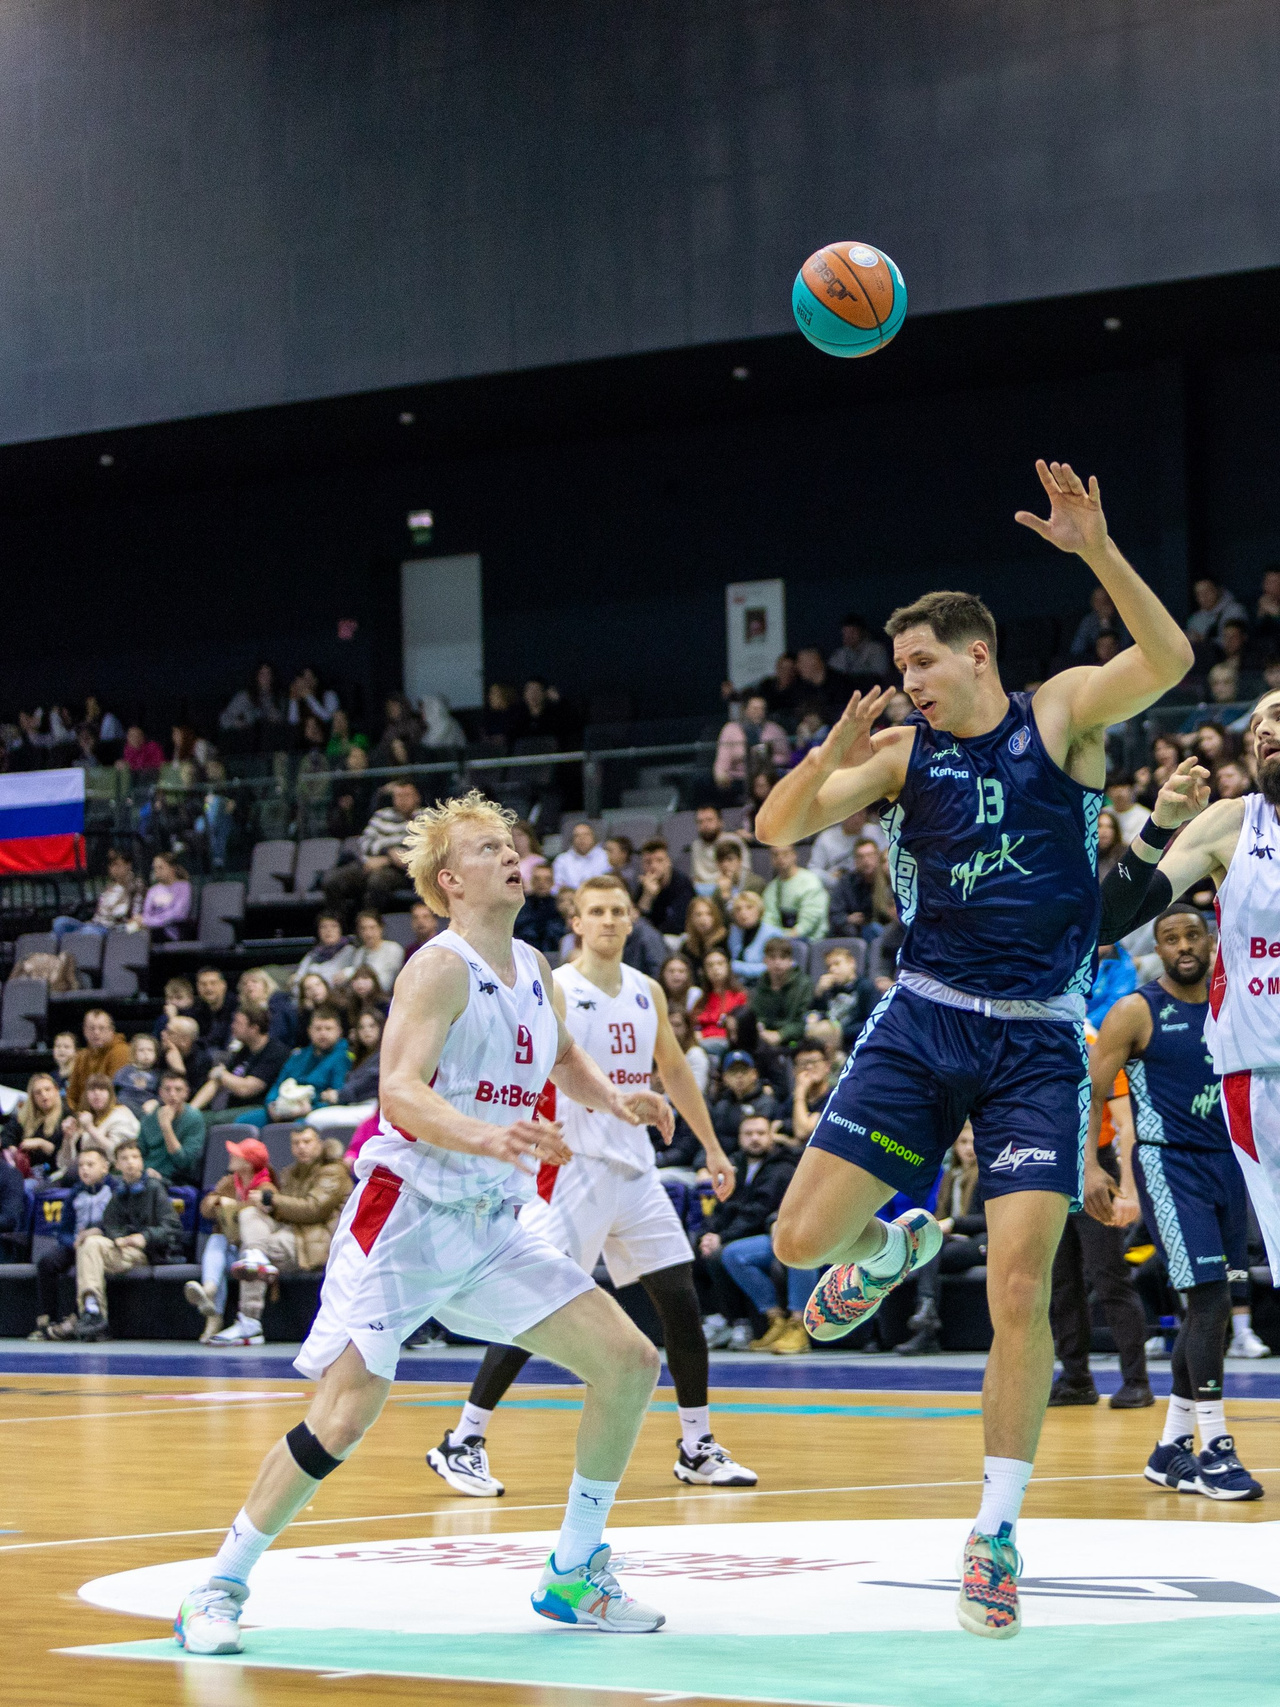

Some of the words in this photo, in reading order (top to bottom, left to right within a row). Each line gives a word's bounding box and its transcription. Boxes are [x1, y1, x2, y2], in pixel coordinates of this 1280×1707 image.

[929, 766, 969, 779] Kempa
[975, 776, 1004, 824] 13
[515, 1024, 533, 1064] 9
[608, 1022, 636, 1054] 33
[609, 1069, 651, 1085] tBoo
[826, 1110, 866, 1136] Kempa
[870, 1130, 925, 1168] евроопт
[296, 1550, 805, 1581] BELRUS
